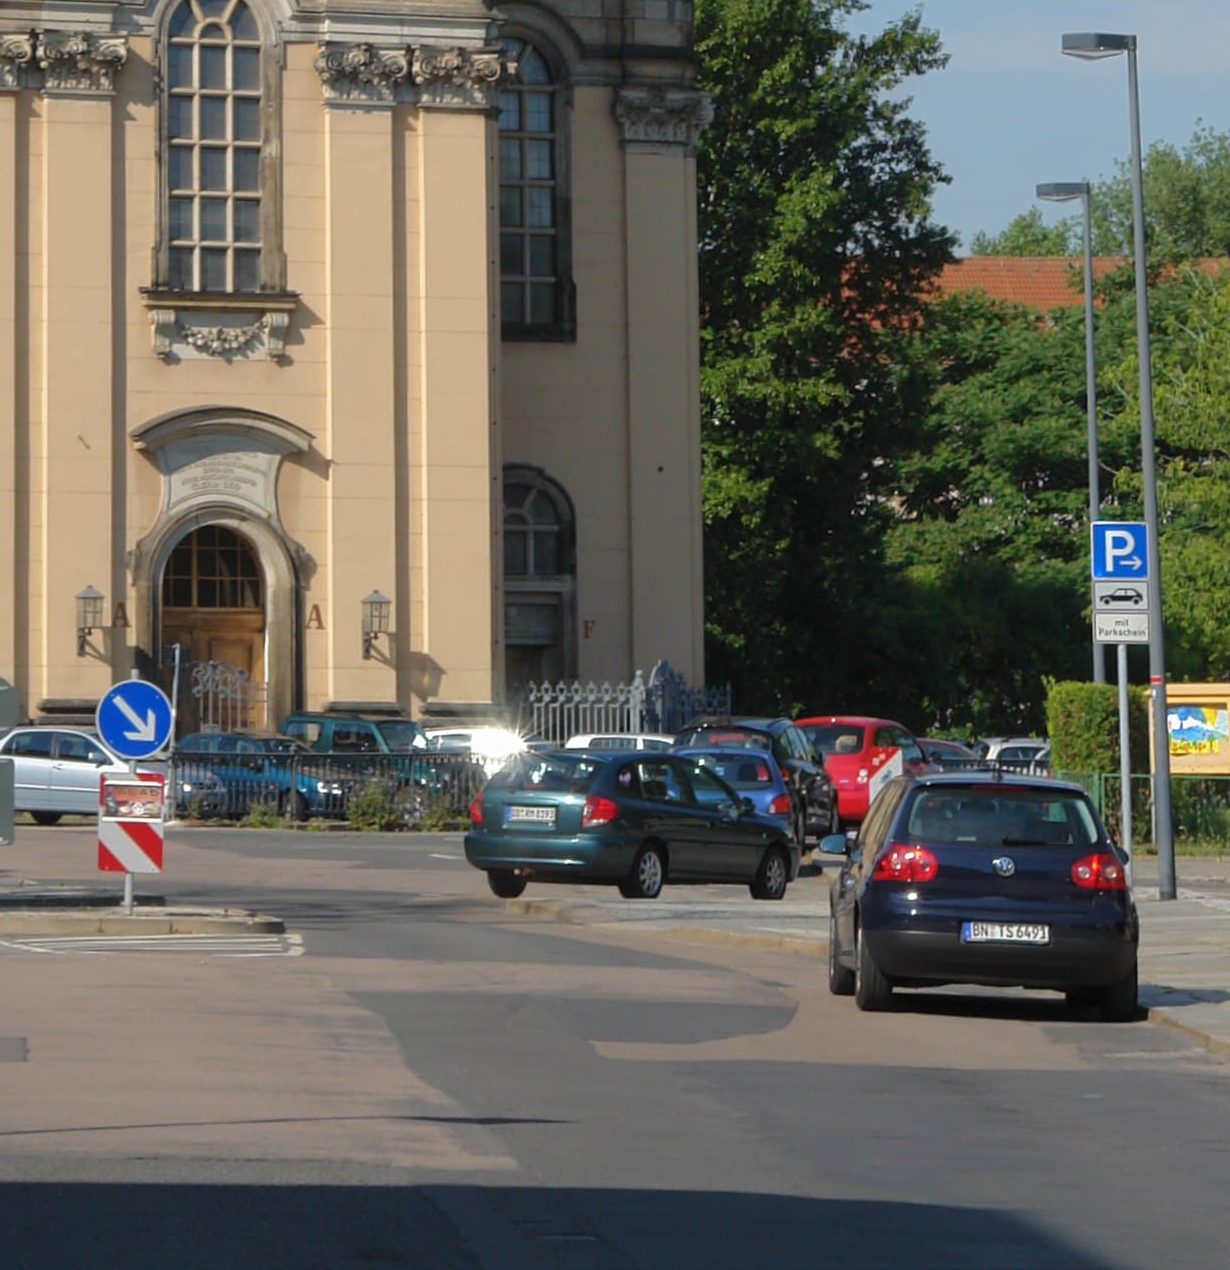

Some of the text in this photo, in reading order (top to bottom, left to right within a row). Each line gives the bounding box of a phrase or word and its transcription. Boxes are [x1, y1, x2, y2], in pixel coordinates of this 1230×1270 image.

[1105, 530, 1135, 572] P
[305, 603, 327, 630] A
[1114, 619, 1129, 627] mit
[1098, 627, 1146, 637] Parkschein
[972, 923, 1047, 939] BN TS 6491
